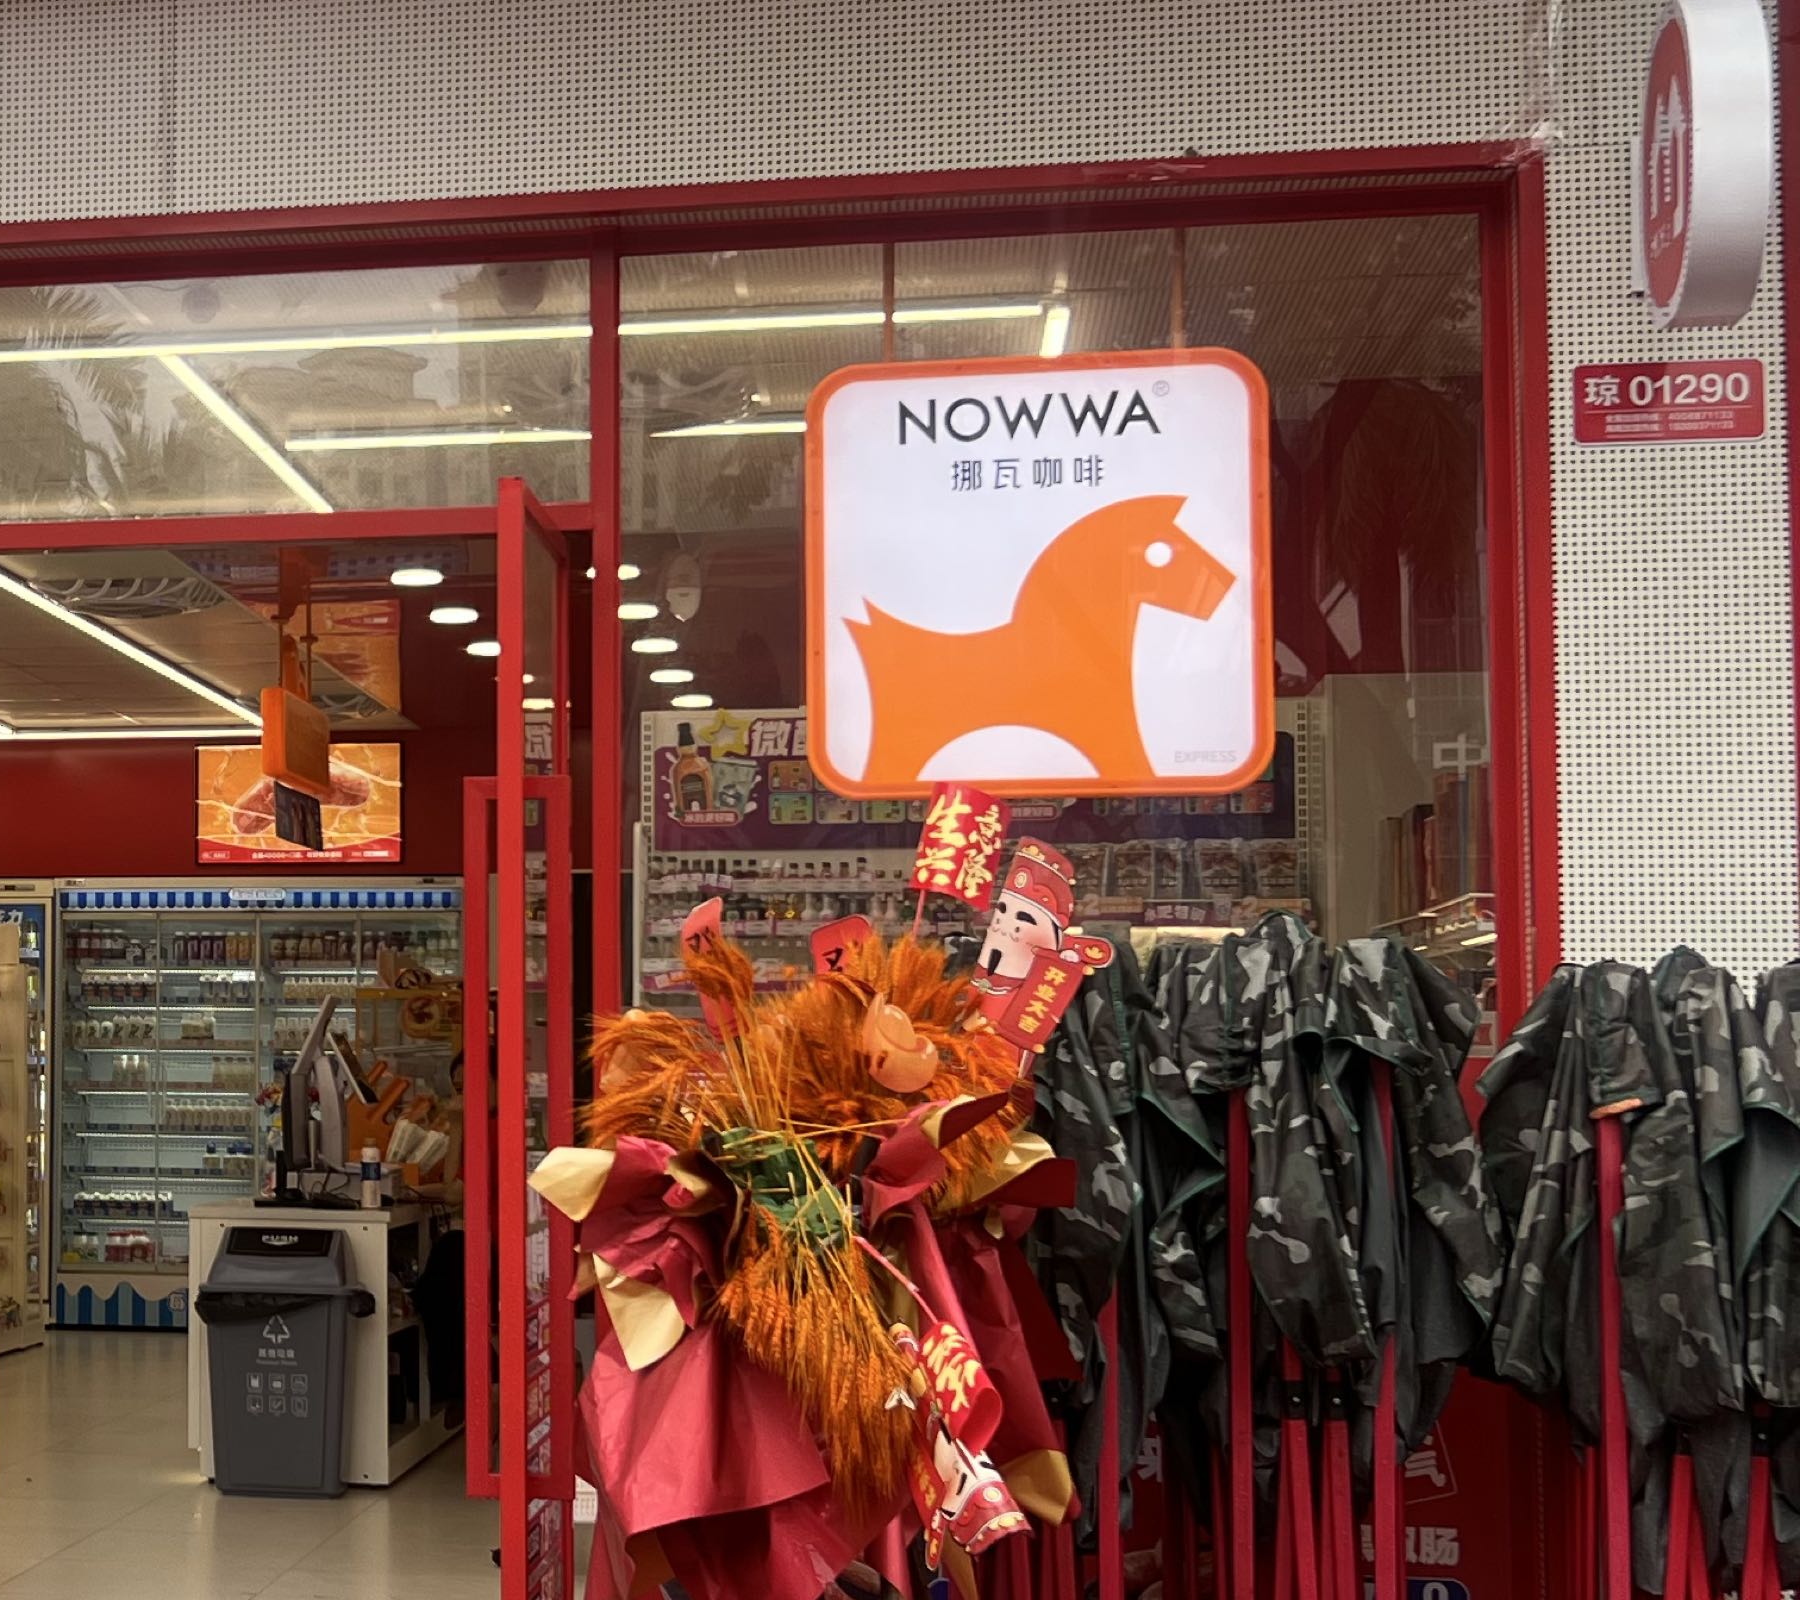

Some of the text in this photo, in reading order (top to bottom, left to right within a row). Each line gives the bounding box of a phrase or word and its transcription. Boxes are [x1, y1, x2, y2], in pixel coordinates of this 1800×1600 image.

[1584, 373, 1749, 406] 琼 01290
[899, 390, 1161, 444] NOWWA
[951, 454, 1104, 491] 挪瓦咖啡
[750, 718, 807, 758] 微
[1174, 750, 1237, 764] EXPRESS
[927, 789, 1003, 857] 生意
[915, 846, 994, 900] 兴隆
[1017, 964, 1070, 1035] 开业大吉
